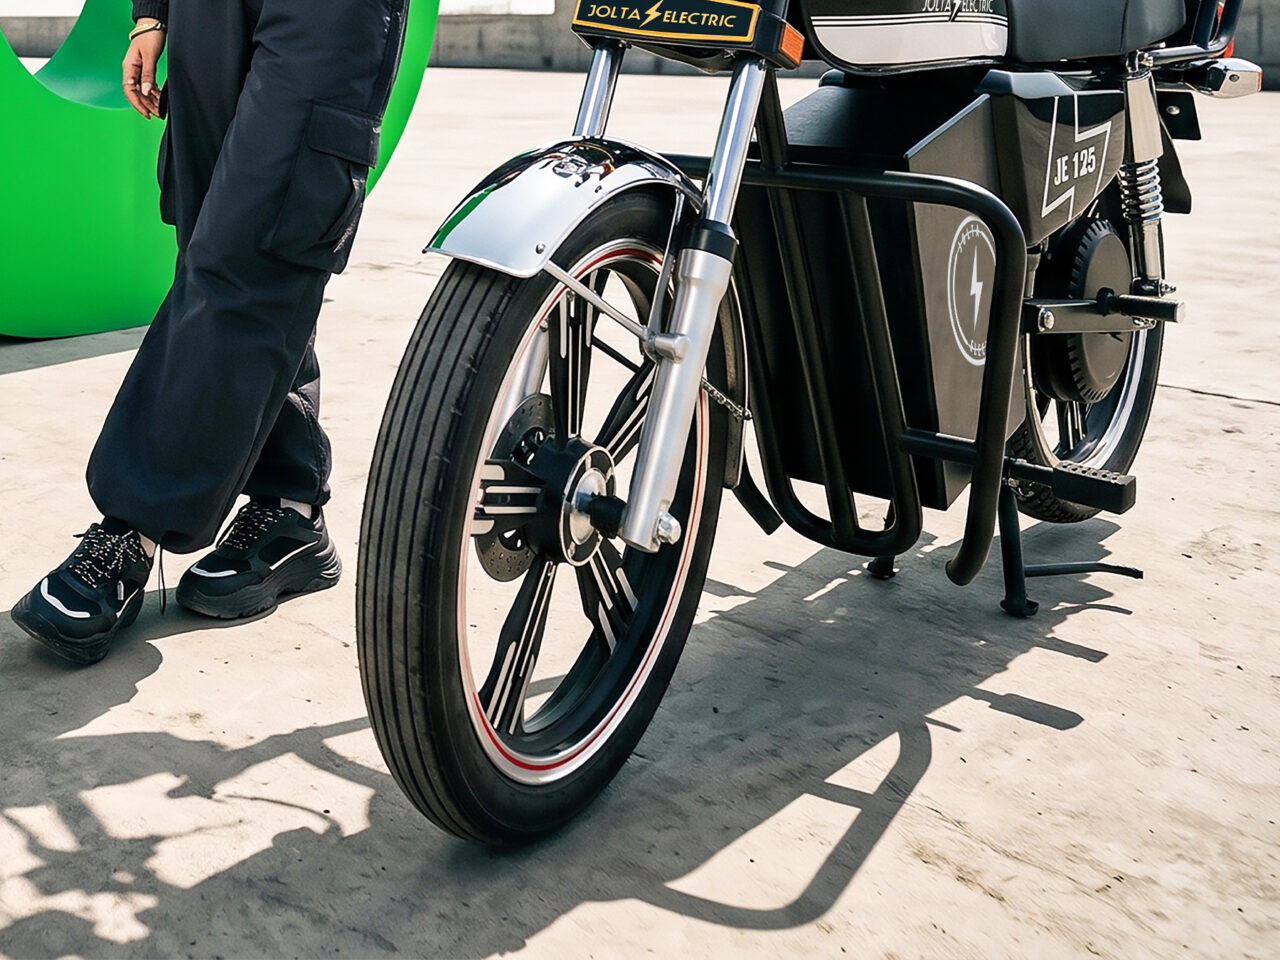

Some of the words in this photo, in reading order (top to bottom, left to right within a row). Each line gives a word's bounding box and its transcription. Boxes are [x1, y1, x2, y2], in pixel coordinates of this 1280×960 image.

[587, 4, 641, 21] JOLTA
[662, 10, 737, 28] ELECTRIC
[1053, 155, 1070, 186] JE
[1072, 145, 1096, 179] 125
